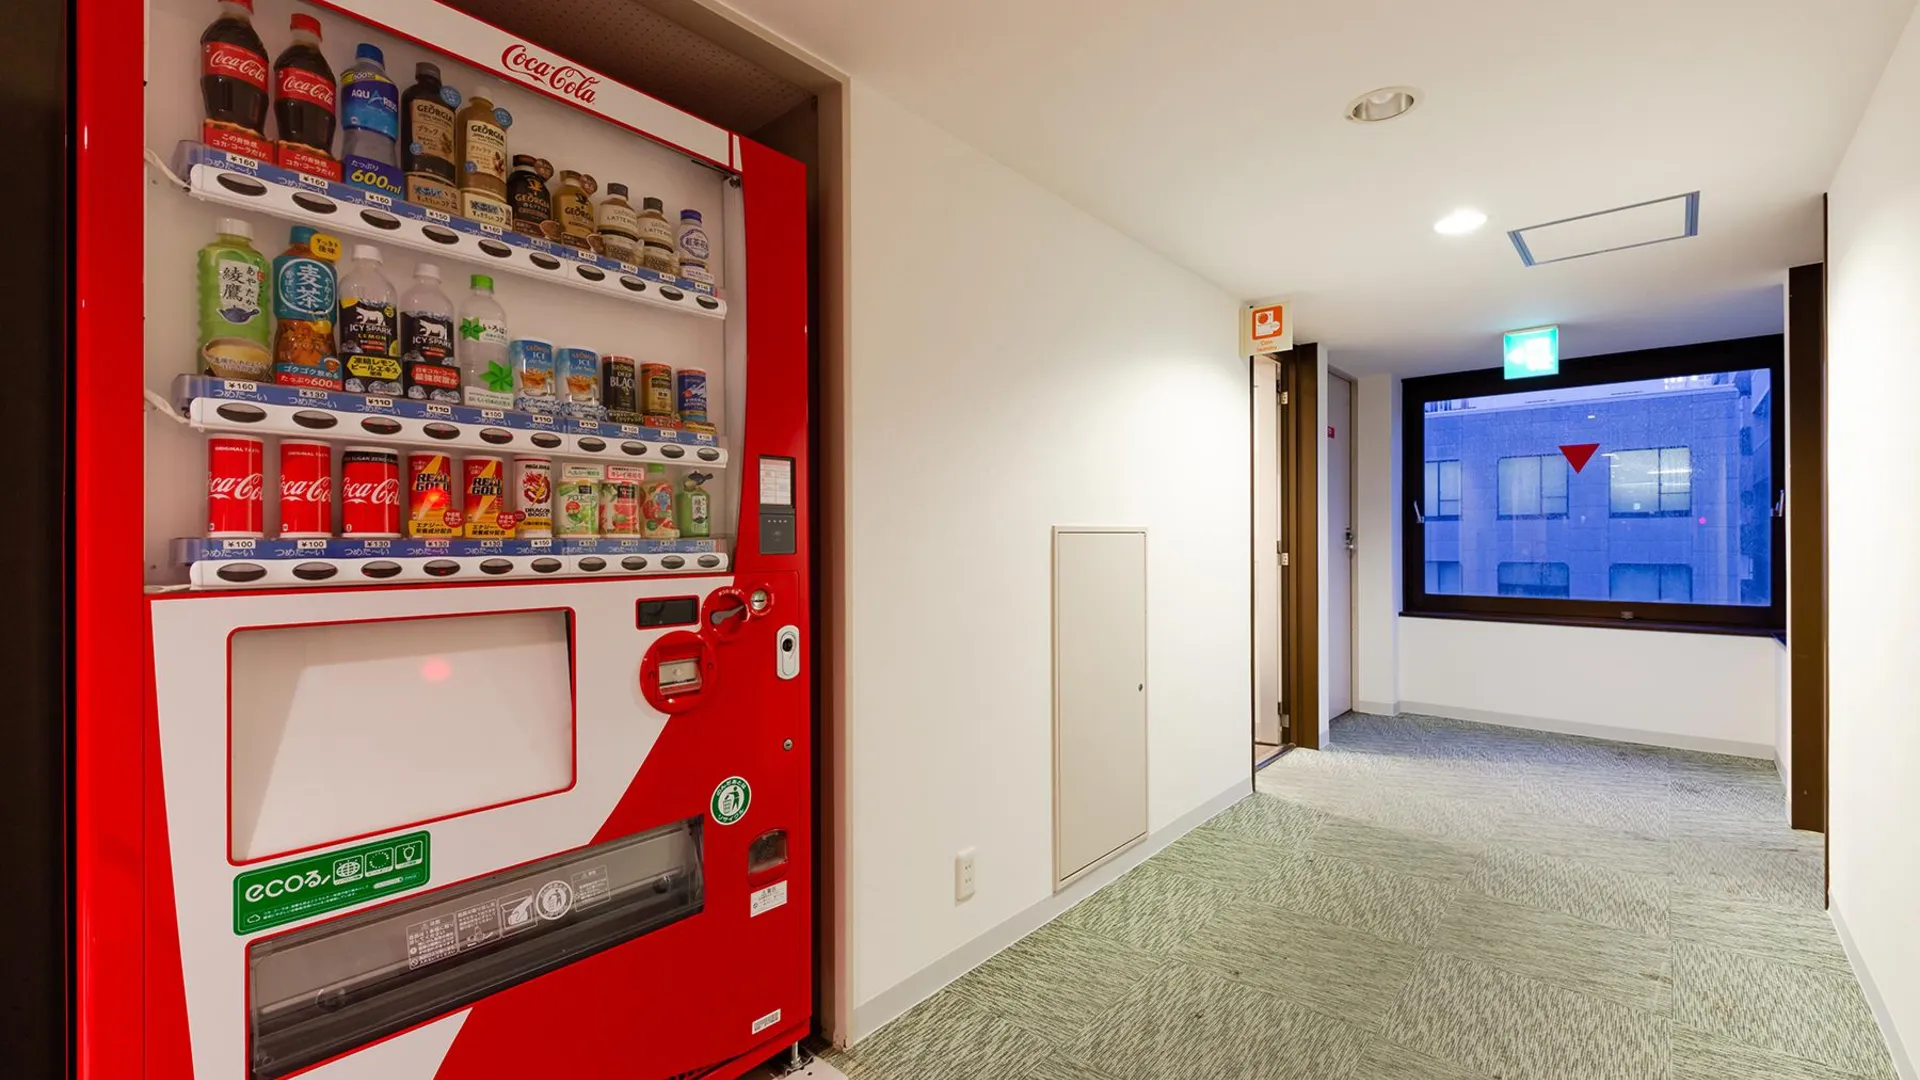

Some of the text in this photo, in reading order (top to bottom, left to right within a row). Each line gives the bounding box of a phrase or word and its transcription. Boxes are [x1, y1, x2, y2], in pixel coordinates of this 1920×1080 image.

[210, 50, 266, 82] Coca-Cola
[501, 44, 600, 104] Coca-Cola
[283, 75, 334, 105] Coca-Cola
[296, 264, 324, 309] 麦茶
